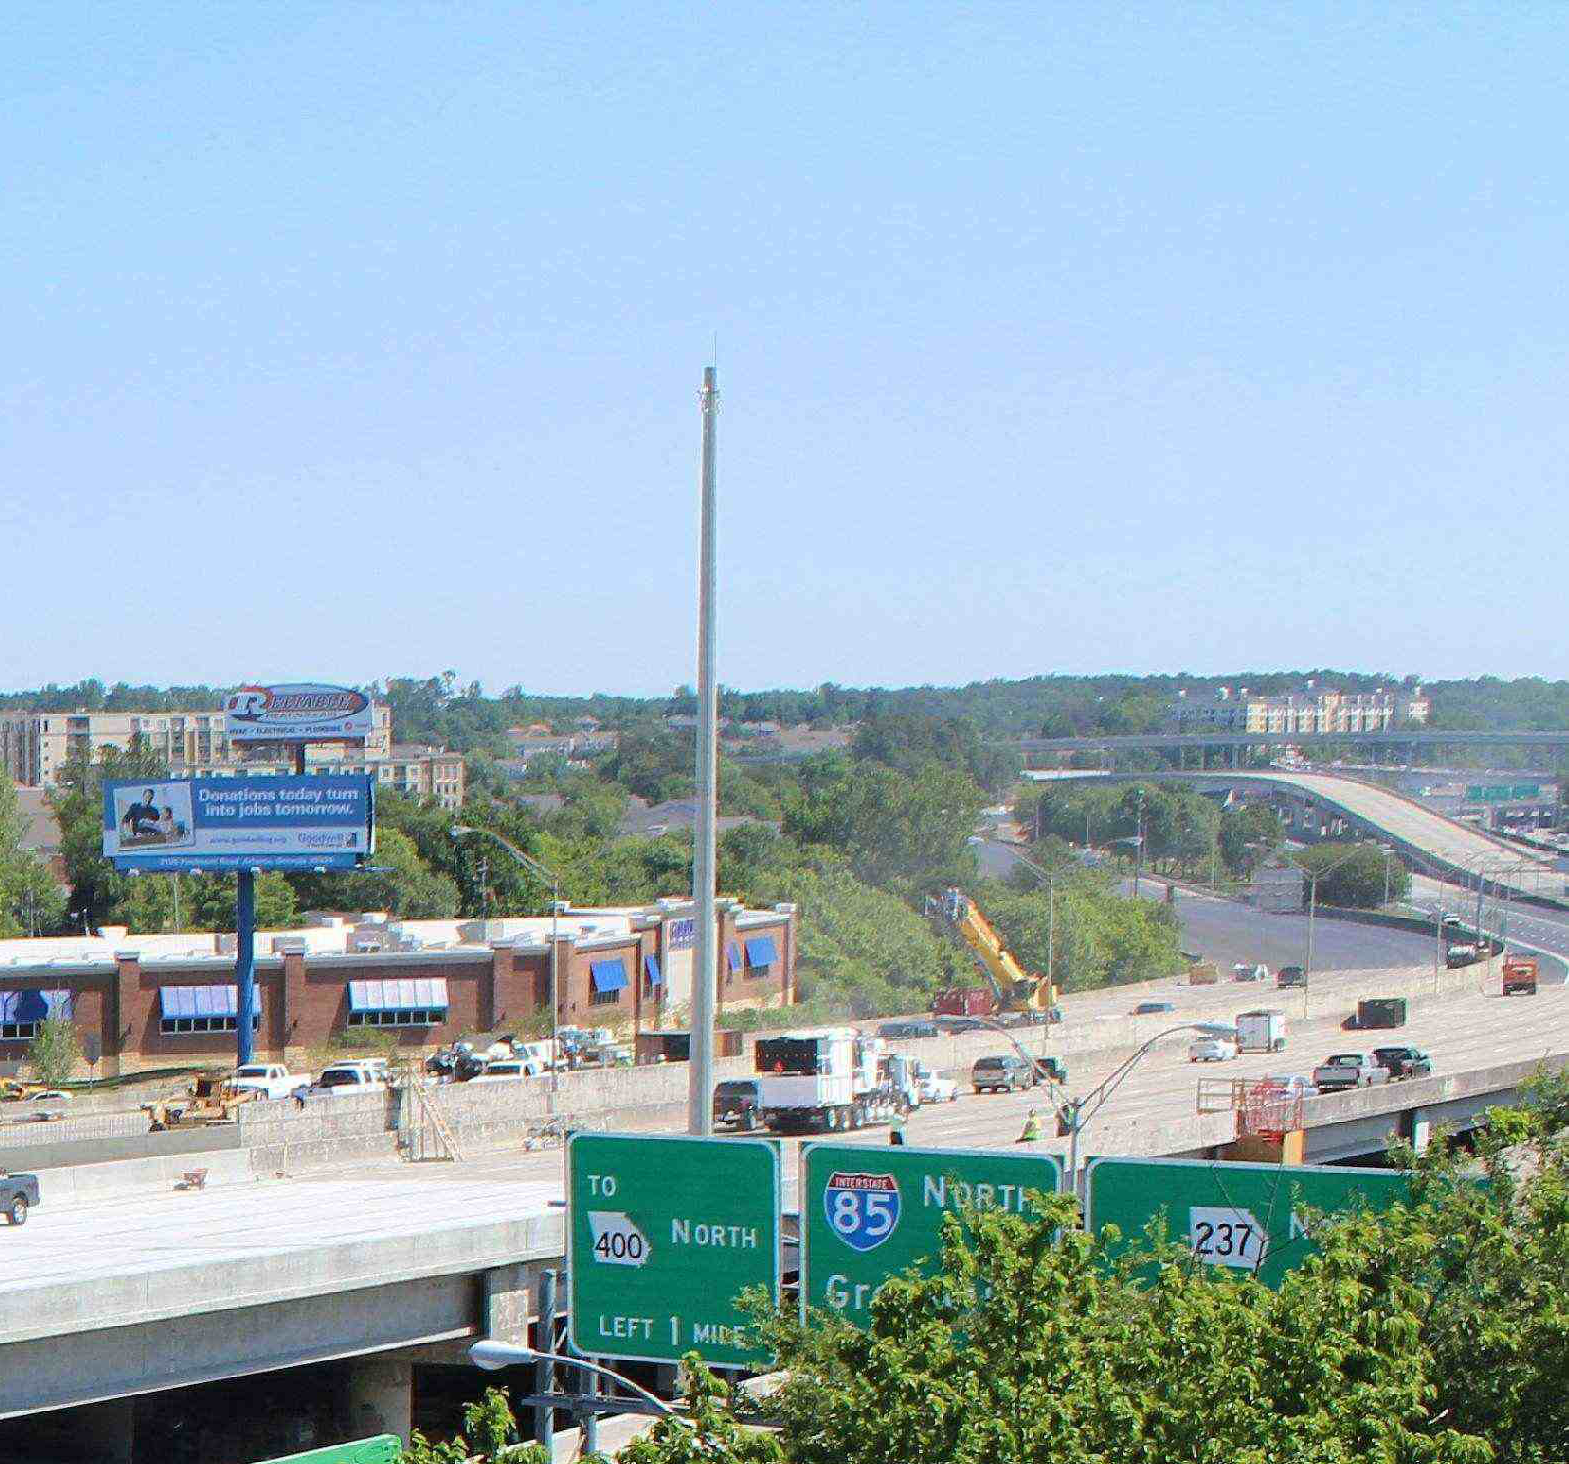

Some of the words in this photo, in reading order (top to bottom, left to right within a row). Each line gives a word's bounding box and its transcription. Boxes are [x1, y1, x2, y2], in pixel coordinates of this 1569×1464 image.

[199, 786, 276, 802] Donations
[279, 786, 323, 804] today
[325, 787, 360, 801] turn
[205, 802, 236, 817] into
[237, 801, 272, 819] jobs
[274, 803, 355, 817] tomorrow.
[587, 1174, 617, 1197] TO
[833, 1190, 892, 1236] 85
[596, 1232, 642, 1259] 400
[671, 1218, 757, 1249] NORTH
[1194, 1221, 1252, 1257] 237
[599, 1313, 654, 1340] LEFT
[670, 1315, 680, 1346] 1
